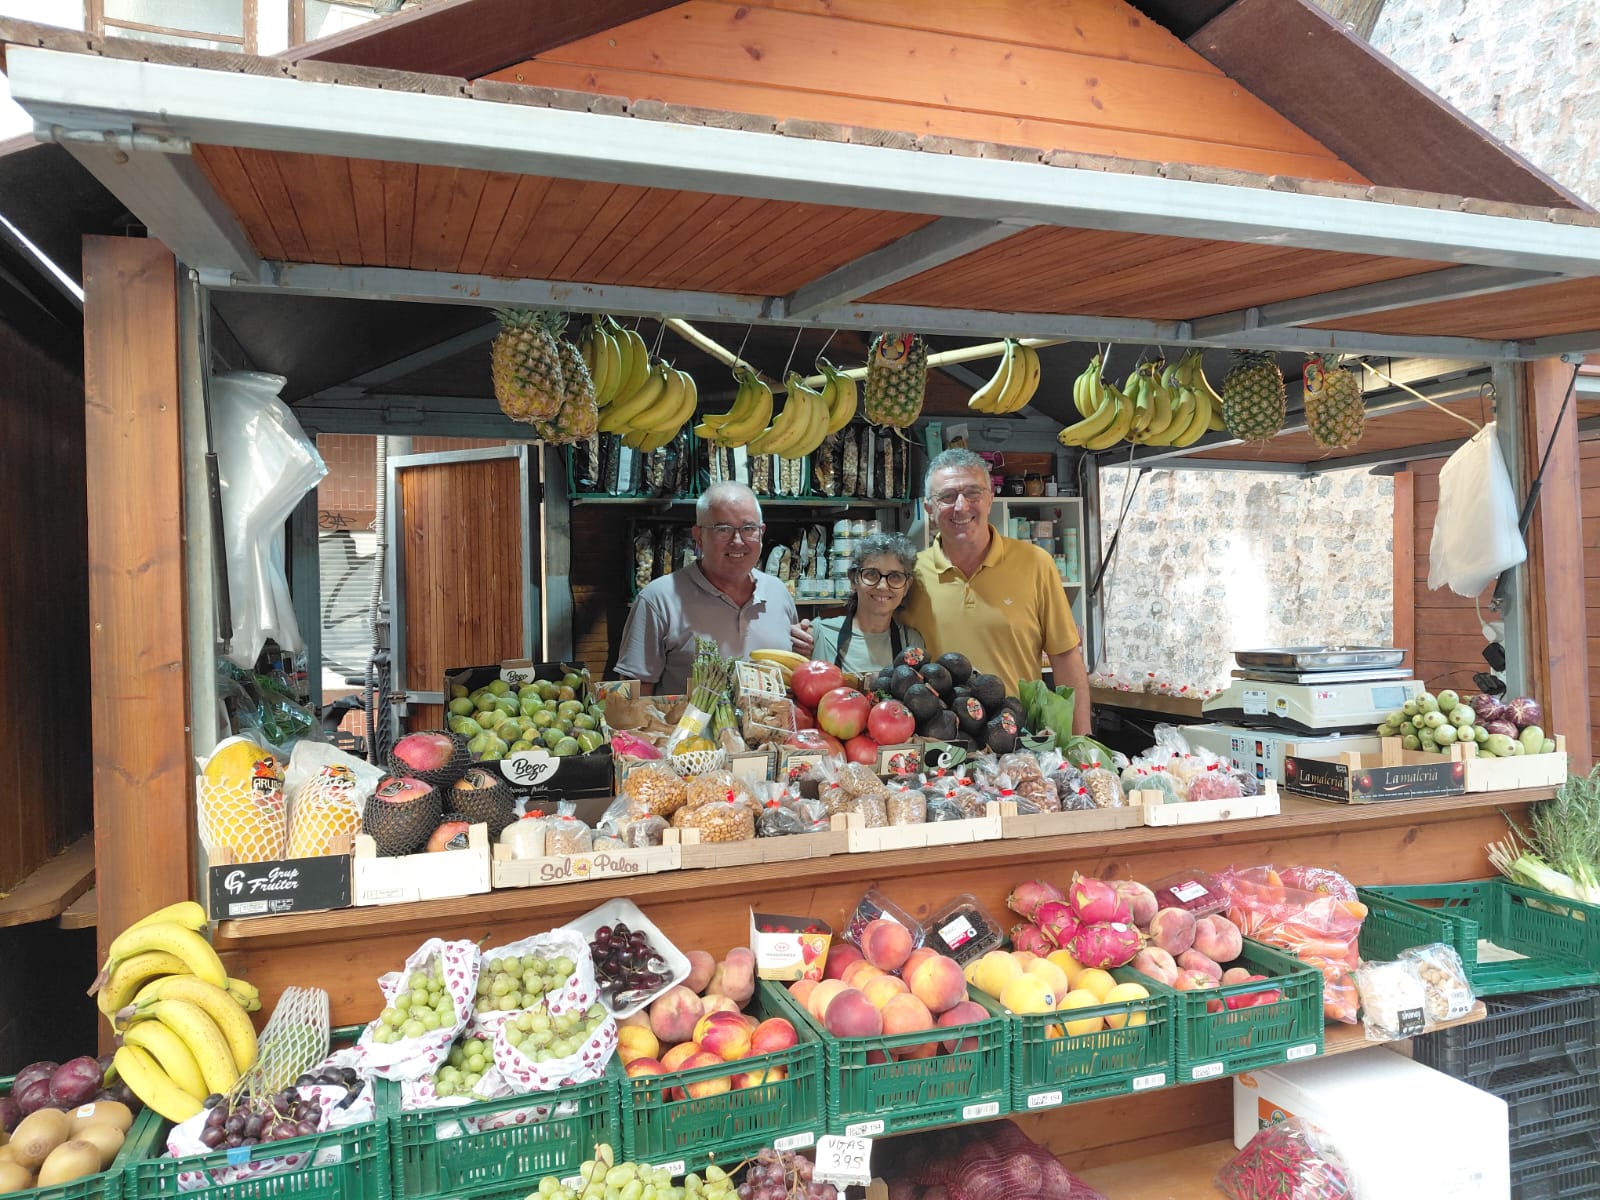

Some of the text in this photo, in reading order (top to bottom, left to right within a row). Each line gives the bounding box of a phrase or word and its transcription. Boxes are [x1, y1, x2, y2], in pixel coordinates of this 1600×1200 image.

[512, 758, 548, 781] Bego
[268, 867, 299, 881] Grup
[540, 854, 639, 881] Sol Palos
[247, 878, 299, 894] Fruiter
